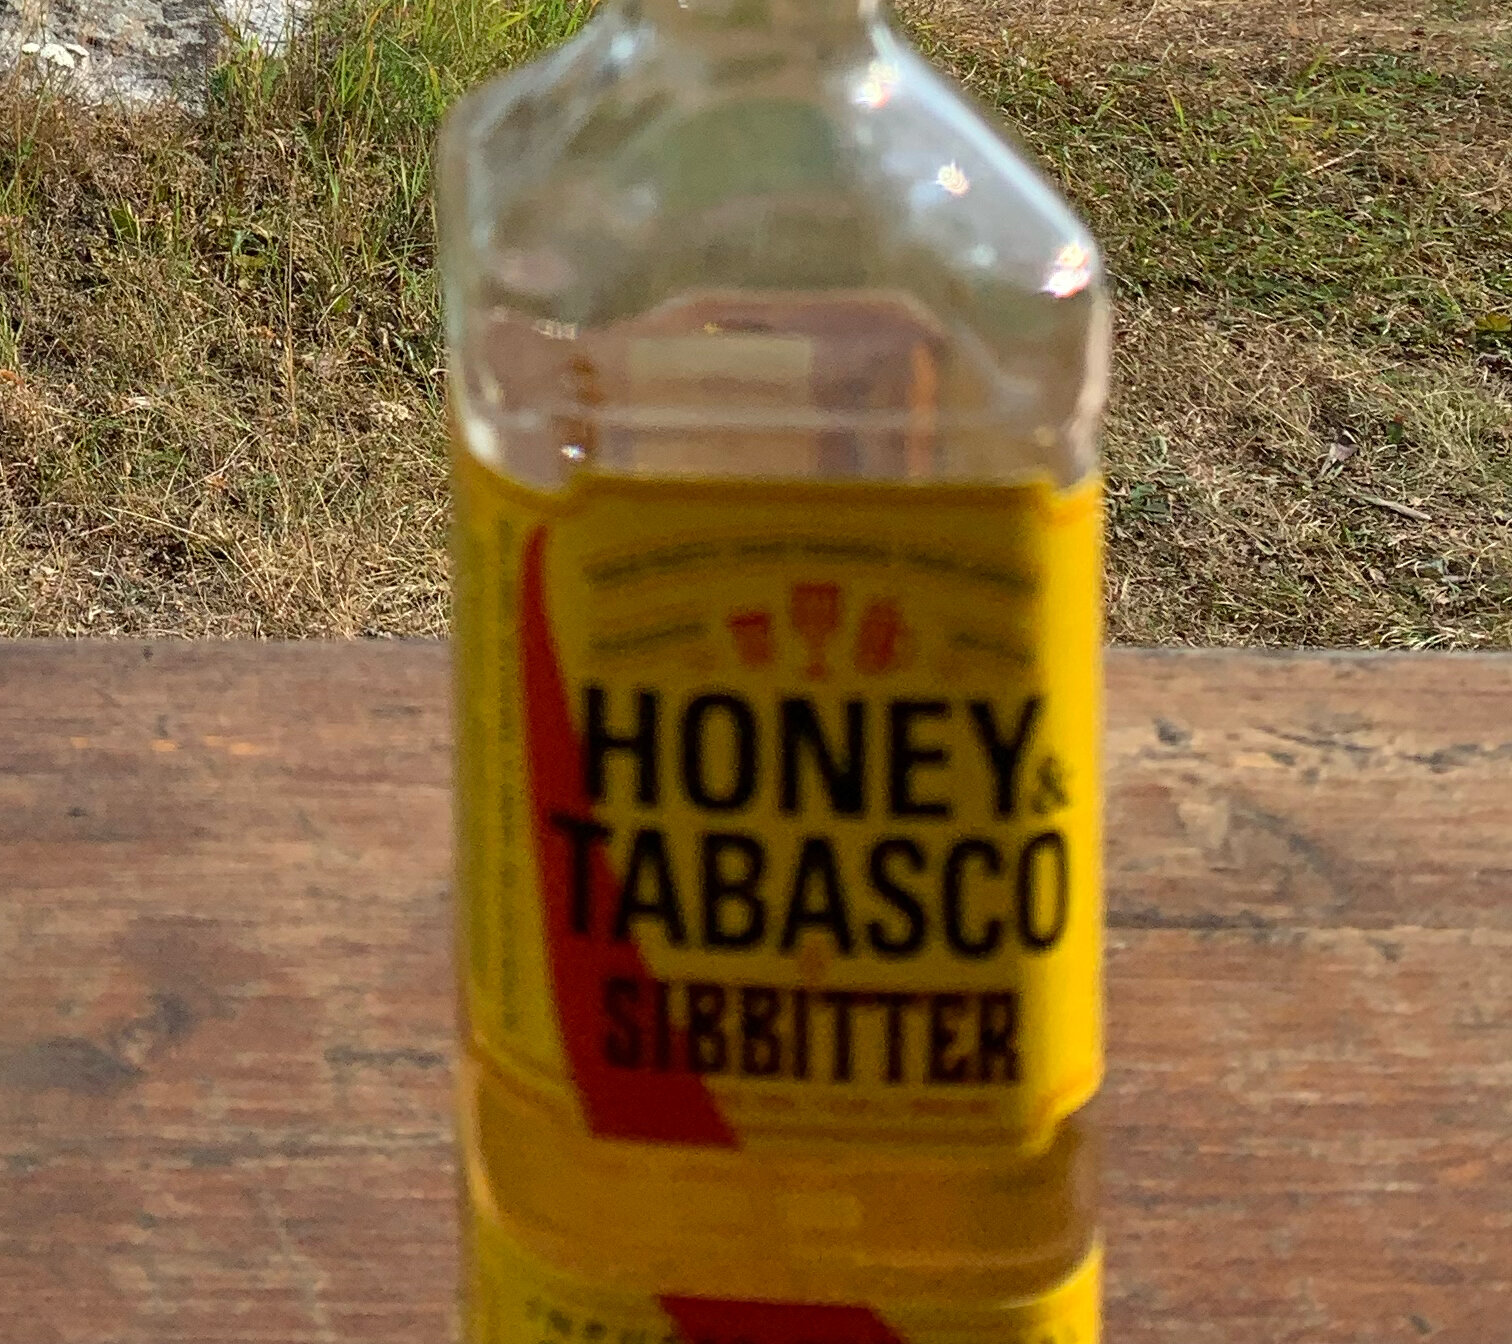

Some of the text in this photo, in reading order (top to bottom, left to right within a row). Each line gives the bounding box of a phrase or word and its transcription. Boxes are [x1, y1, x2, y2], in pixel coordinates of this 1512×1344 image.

[582, 687, 1073, 817] HONEY &
[551, 811, 1070, 959] TABASCO
[603, 978, 1021, 1085] SIBBITTER
